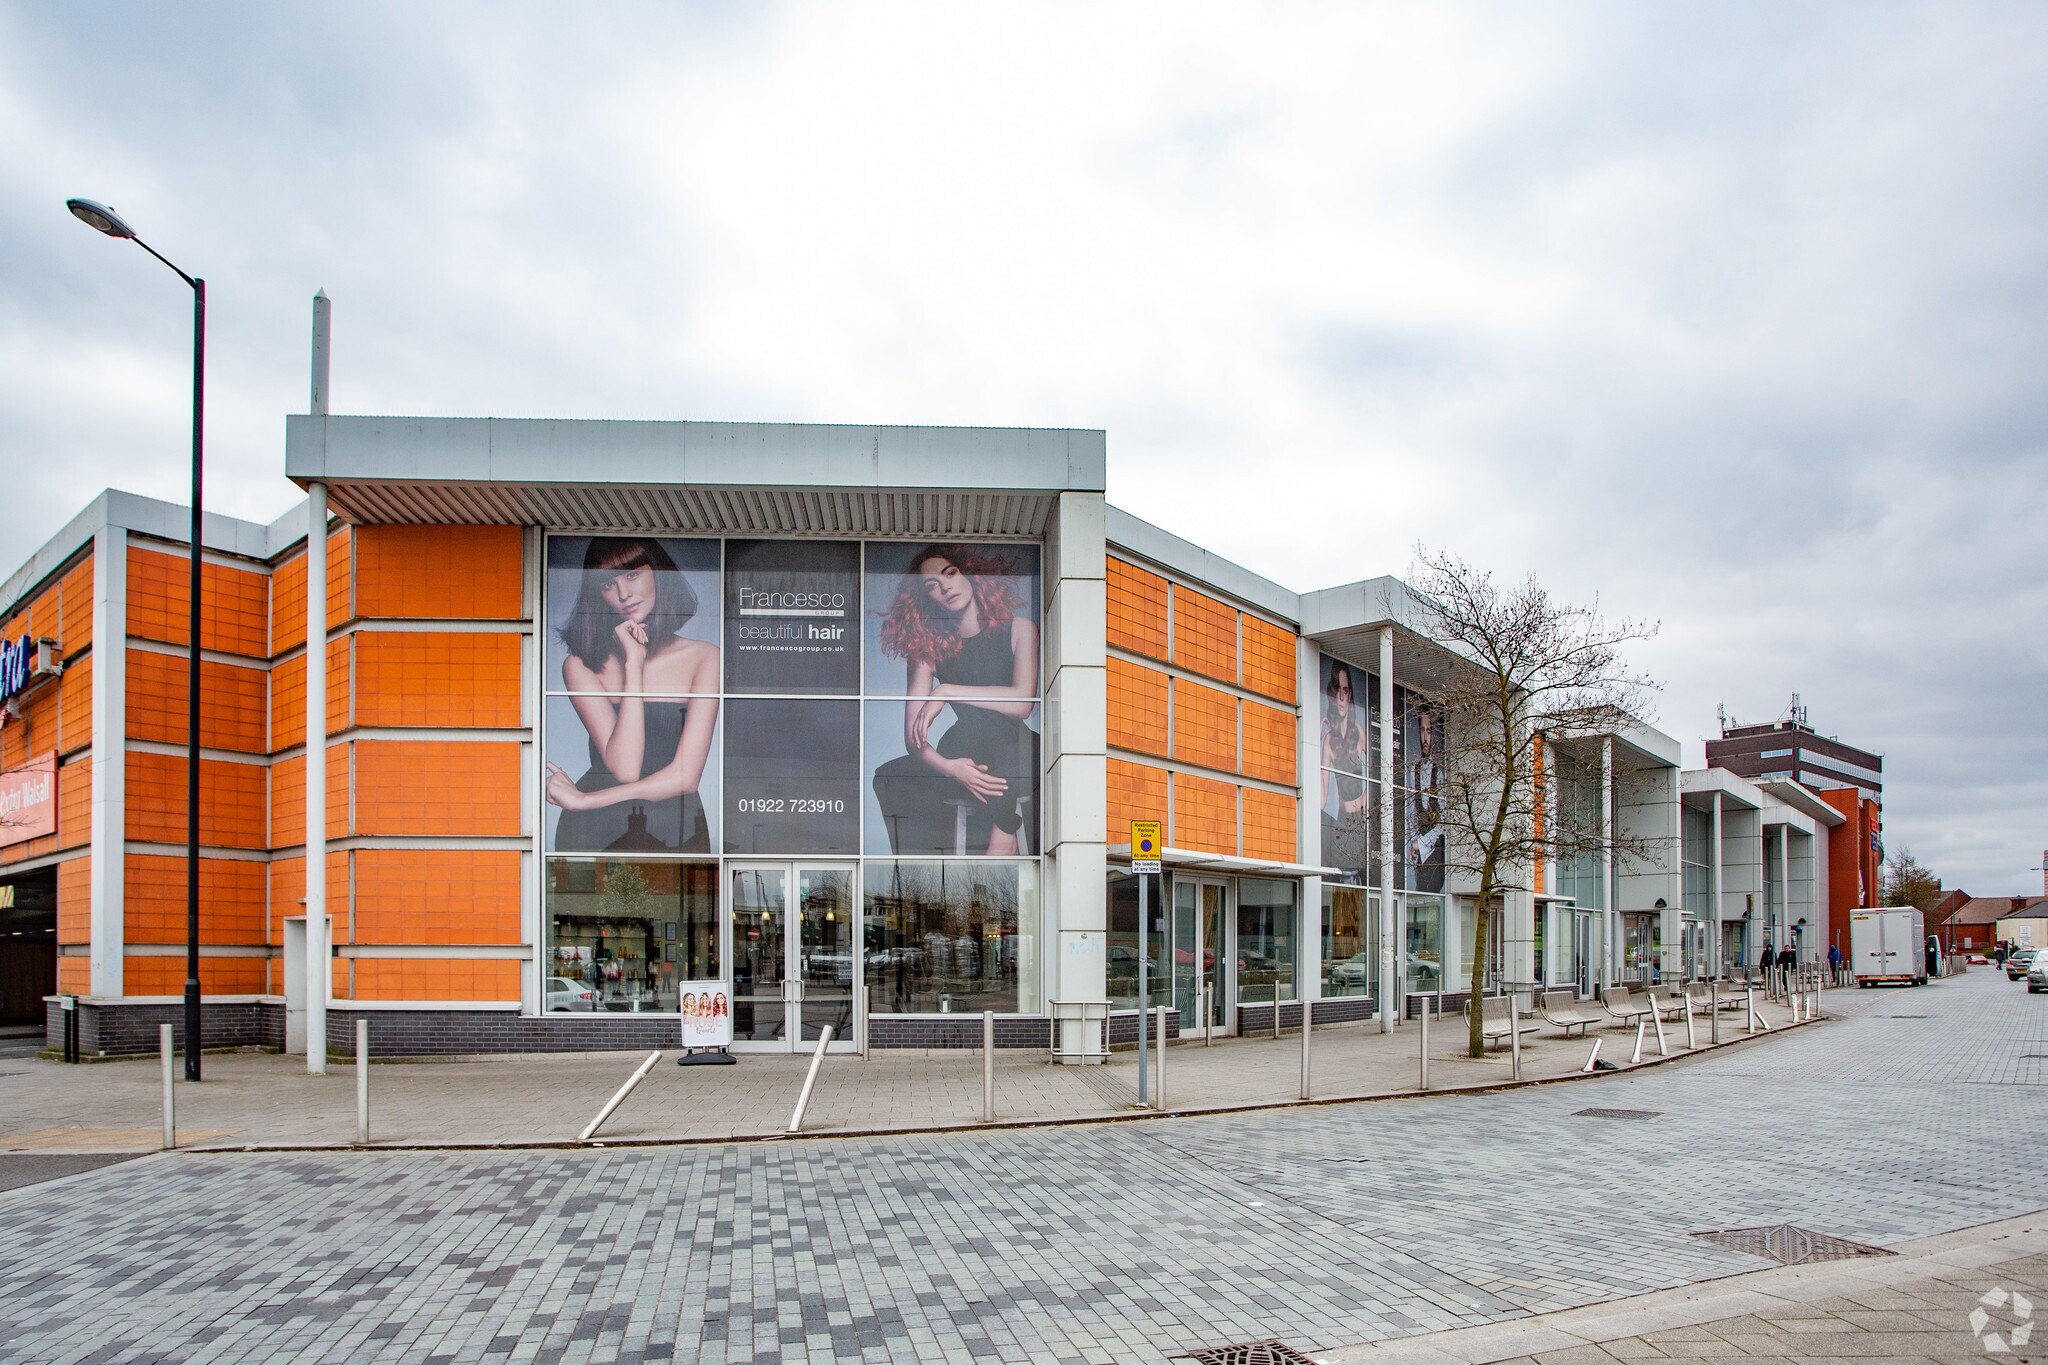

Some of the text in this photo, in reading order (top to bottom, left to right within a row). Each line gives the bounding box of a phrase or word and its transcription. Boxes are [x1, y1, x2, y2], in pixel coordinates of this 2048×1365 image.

[739, 587, 845, 608] Francesco
[739, 623, 844, 640] beautiful hair
[22, 772, 50, 808] Walsall
[738, 798, 844, 813] 01922 723910
